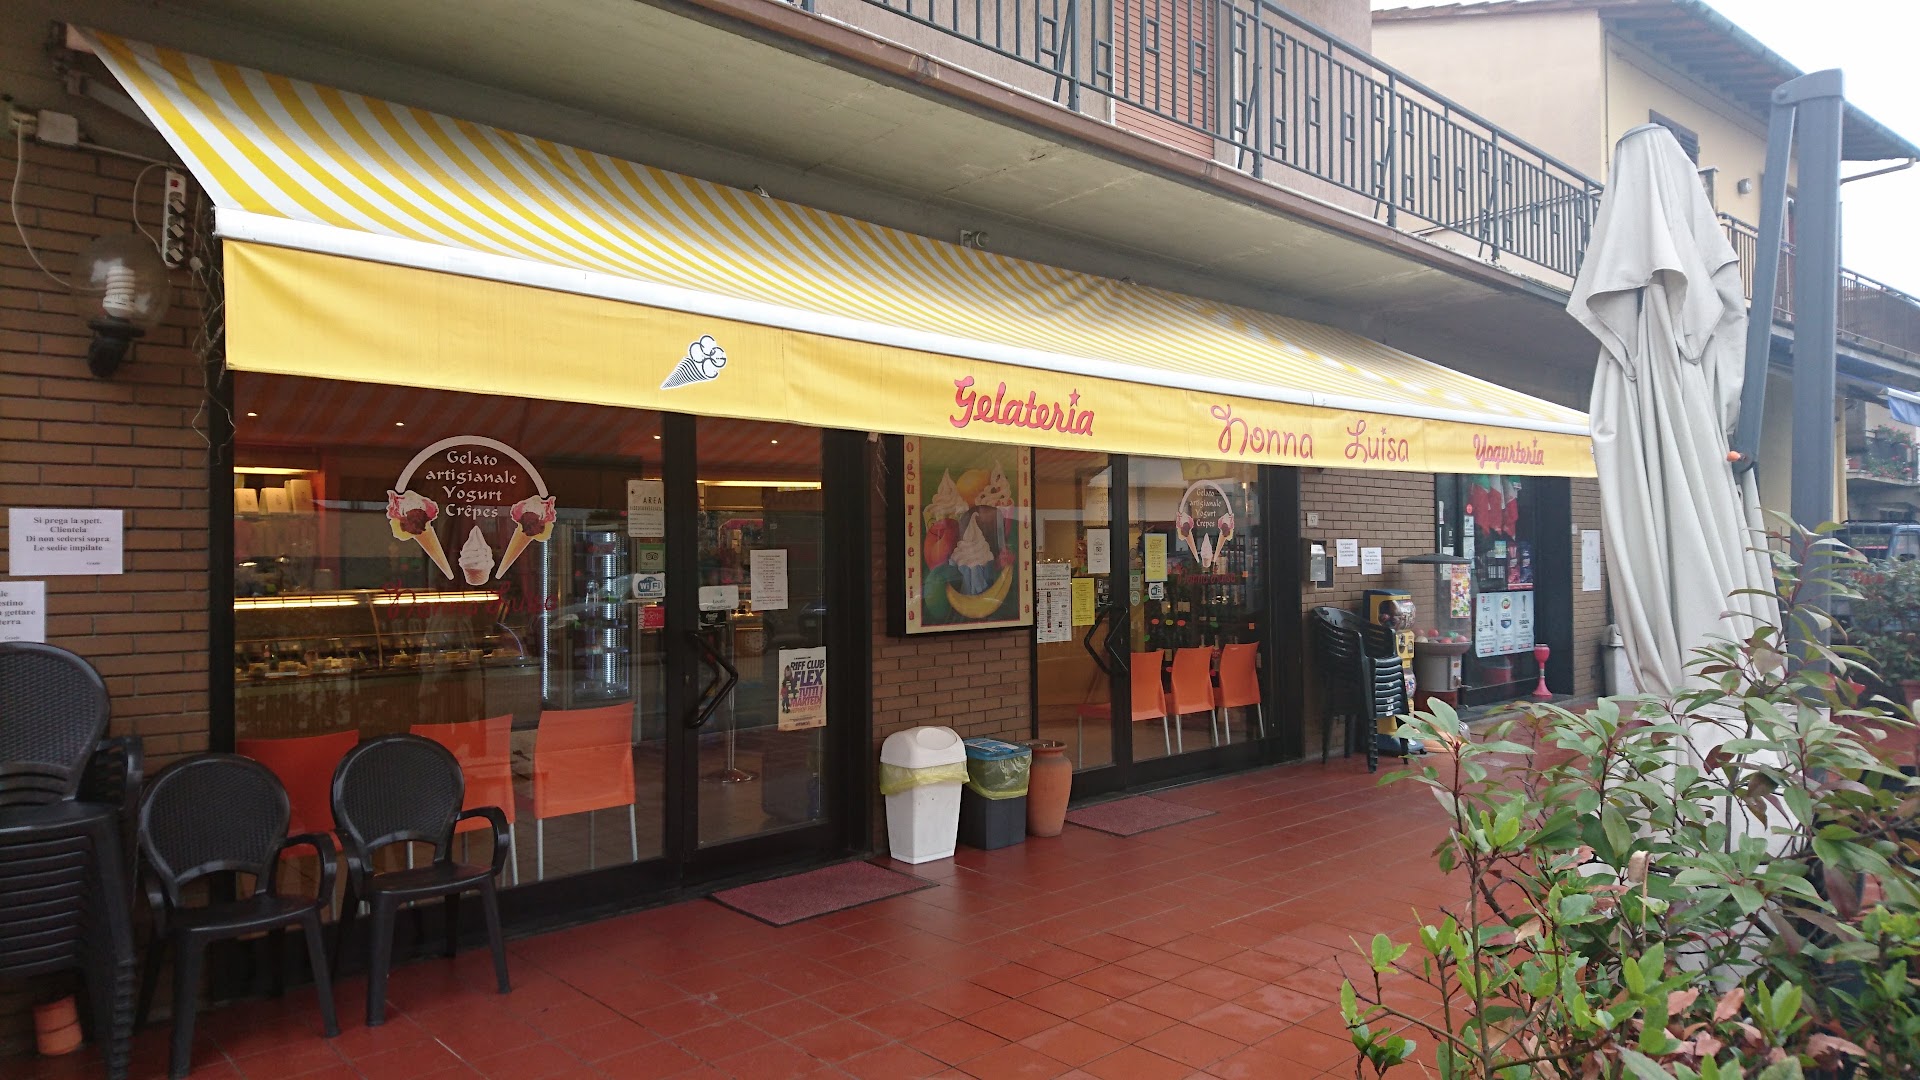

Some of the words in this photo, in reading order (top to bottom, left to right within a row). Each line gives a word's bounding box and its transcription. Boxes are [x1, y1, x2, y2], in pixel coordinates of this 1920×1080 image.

[949, 375, 1095, 437] Gelateria
[1210, 403, 1314, 460] Nonna
[1344, 419, 1409, 463] Luisa
[1473, 433, 1545, 469] Yogurteria
[446, 450, 498, 466] Gelato
[425, 469, 517, 485] artigianale
[442, 485, 502, 502] Yogurt
[1196, 488, 1215, 498] Gelato
[643, 496, 662, 504] AREA
[445, 503, 499, 521] Crêpes
[1195, 508, 1217, 518] Yogurt
[33, 516, 42, 524] Si
[44, 518, 69, 526] prega
[80, 517, 102, 525] spett.
[906, 442, 916, 621] ogurteria
[1022, 446, 1030, 614] elateria
[86, 536, 110, 544] sopra
[69, 544, 103, 553] impilate
[4, 608, 36, 617] gettare
[806, 659, 825, 670] CLUB
[793, 669, 825, 687] FLEX
[798, 686, 819, 698] TUTTI
